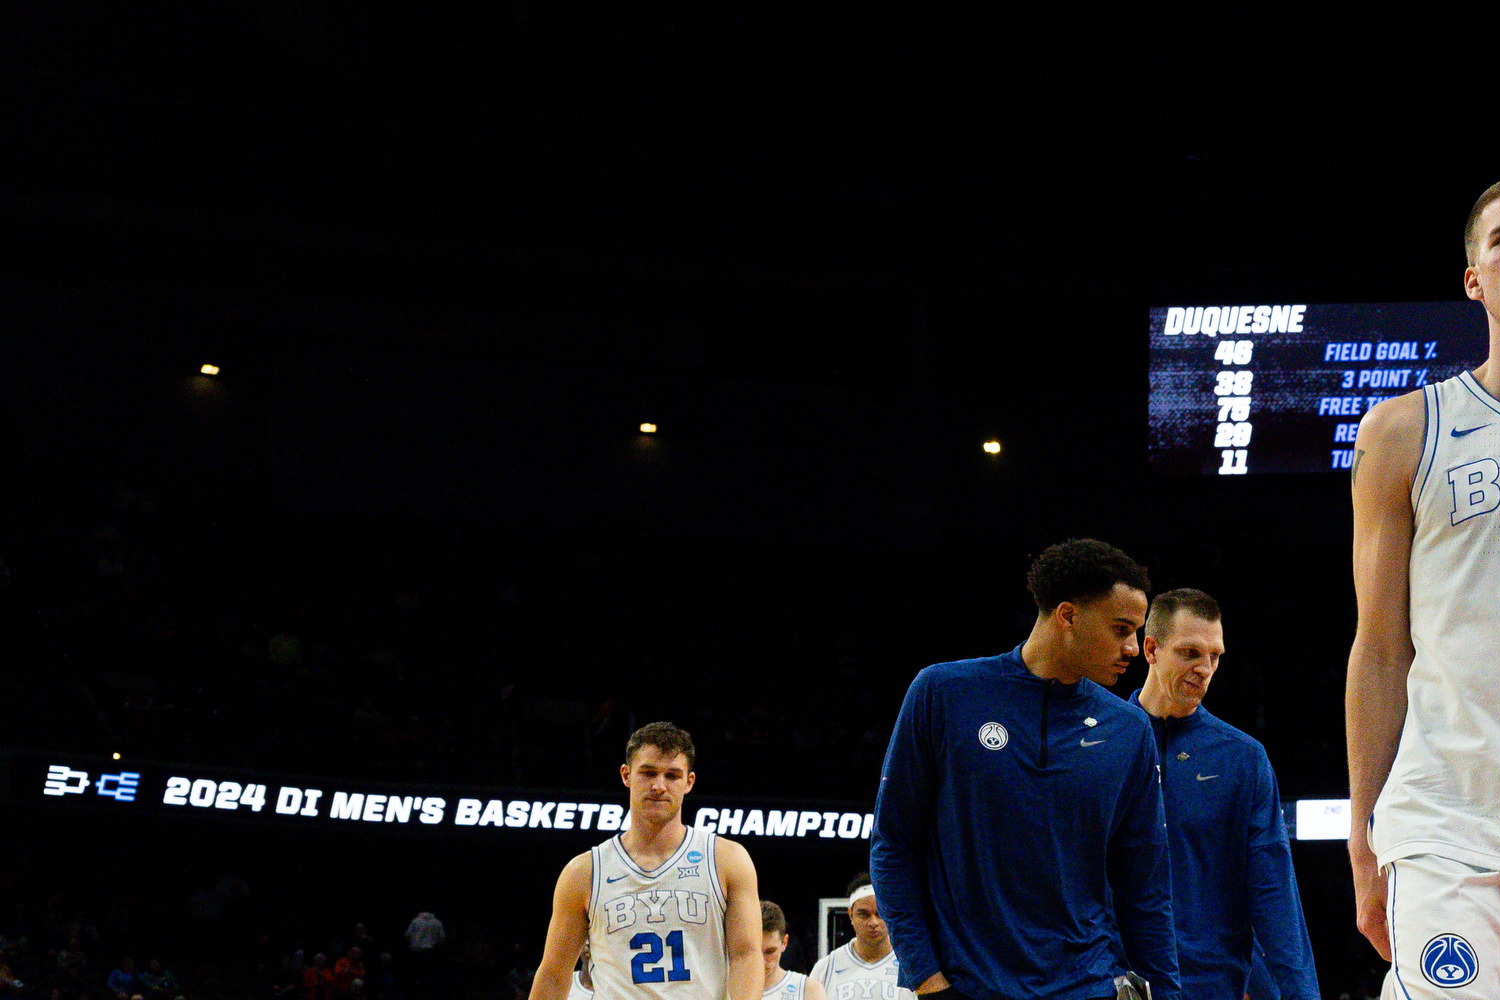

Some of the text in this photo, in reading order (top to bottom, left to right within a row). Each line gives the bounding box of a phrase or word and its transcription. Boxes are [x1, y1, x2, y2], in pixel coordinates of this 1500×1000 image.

[1164, 305, 1307, 337] DUQUESNE
[1214, 340, 1254, 365] 46
[1324, 341, 1437, 361] FIELD GOAL %
[1341, 369, 1428, 389] 3 POINT %
[1217, 397, 1252, 421] 75
[1319, 397, 1362, 416] FREE
[1218, 450, 1248, 475] 11
[163, 776, 266, 812] 2024
[275, 786, 323, 817] DI
[329, 792, 446, 825] MEN'S
[454, 798, 631, 831] BASKETB
[604, 890, 708, 934] BYU
[629, 930, 691, 984] 21
